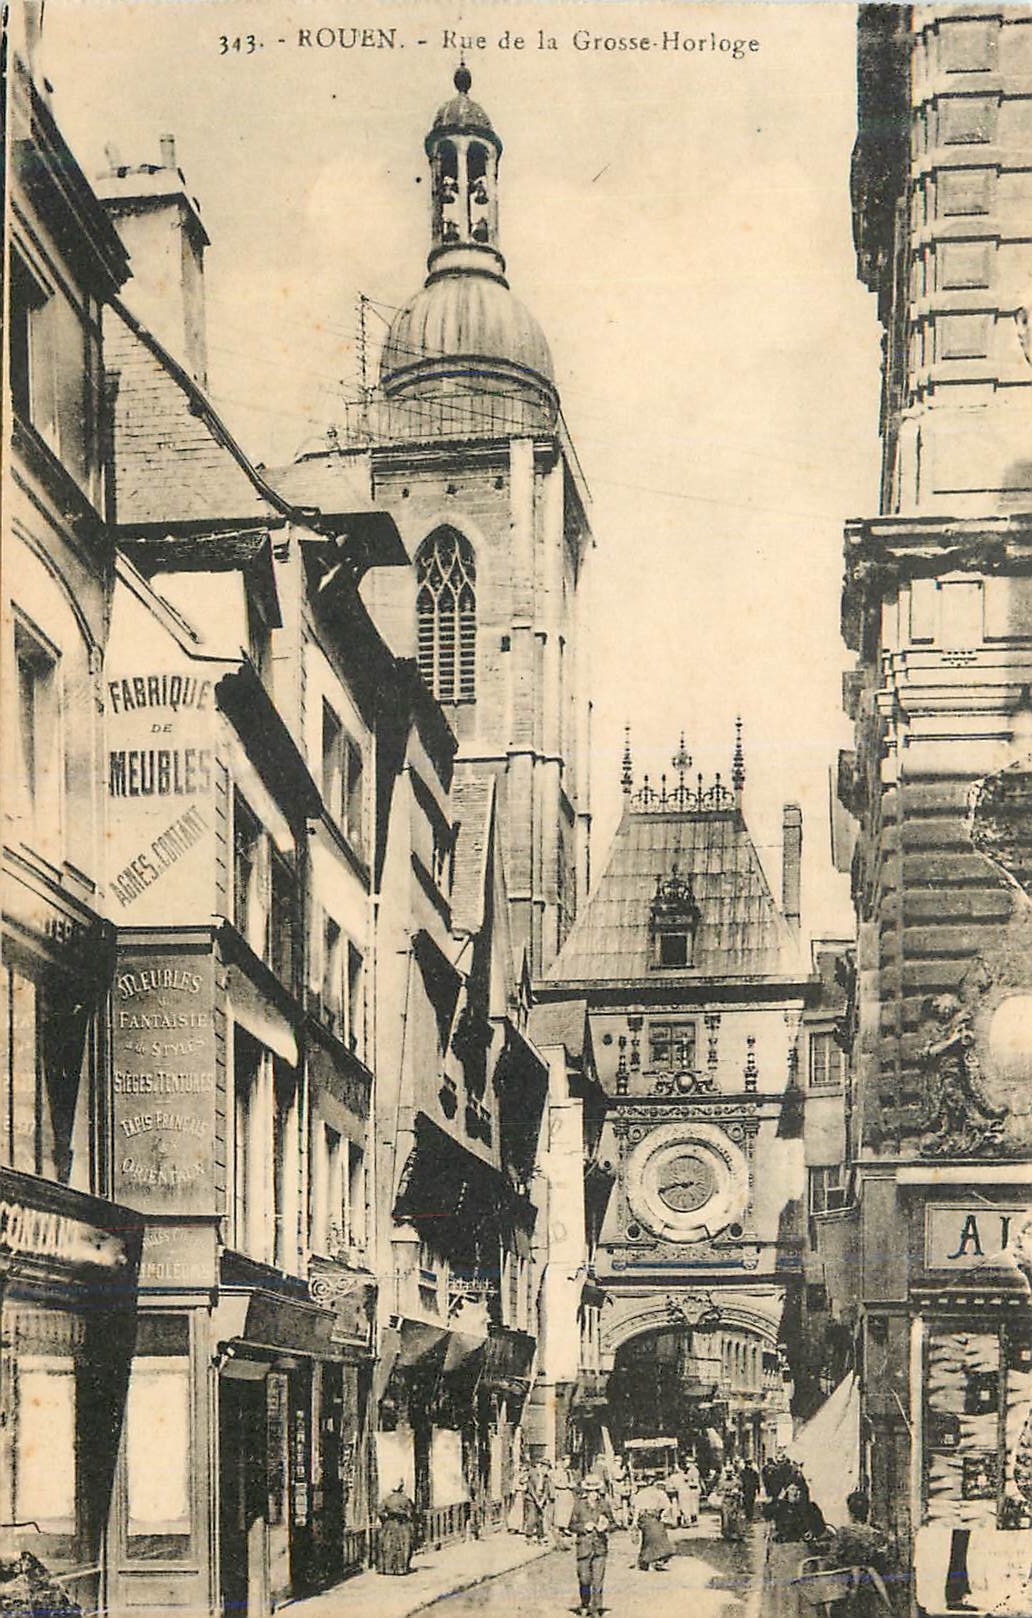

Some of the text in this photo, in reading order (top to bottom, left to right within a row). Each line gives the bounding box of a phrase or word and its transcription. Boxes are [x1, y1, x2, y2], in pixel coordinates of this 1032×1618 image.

[108, 675, 212, 714] FABRIQUE
[151, 724, 173, 733] DE
[108, 749, 212, 798] MEUBLES
[116, 968, 204, 1001] MEUBLES
[119, 1011, 208, 1030] FANTAISIE
[120, 1114, 153, 1138] TAPIS
